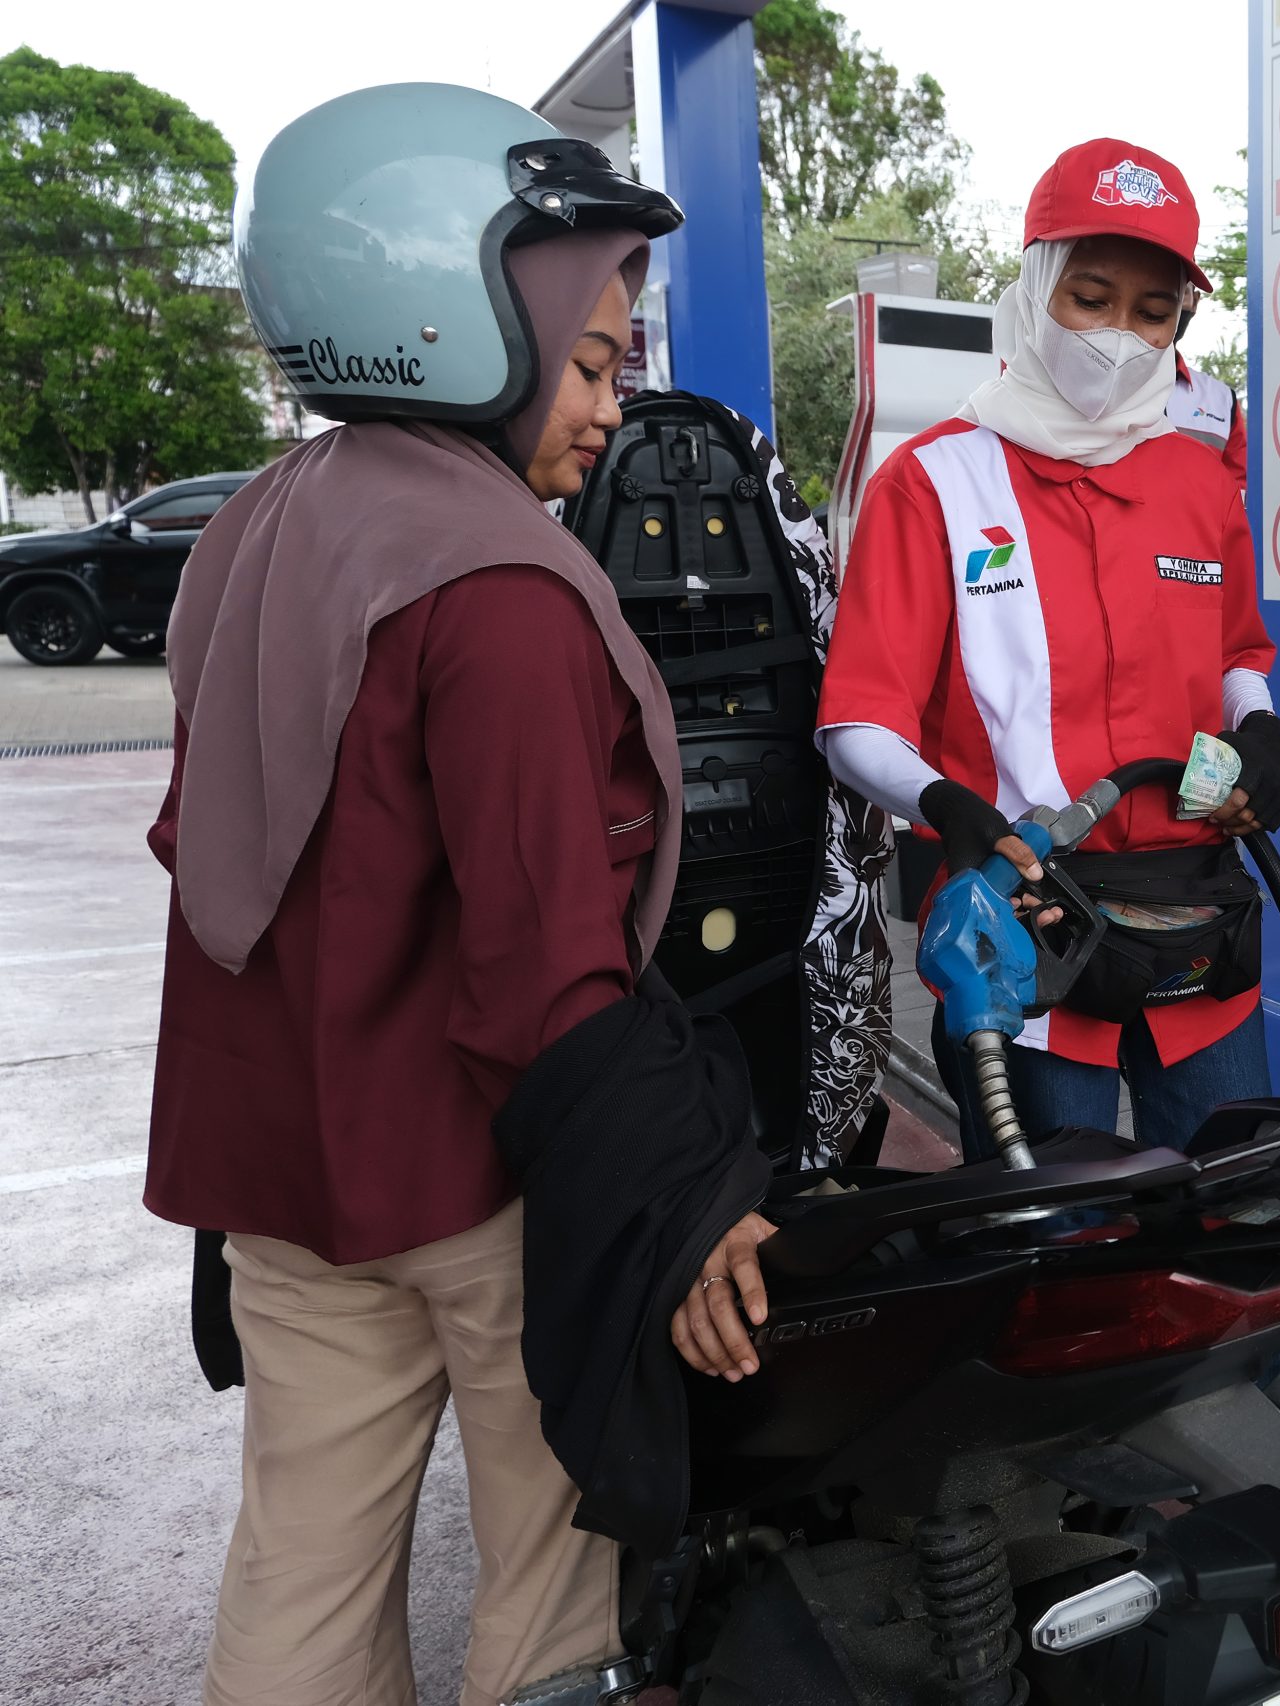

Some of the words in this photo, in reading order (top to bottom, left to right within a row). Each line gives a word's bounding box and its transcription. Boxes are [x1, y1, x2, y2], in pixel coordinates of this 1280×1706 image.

[1117, 172, 1134, 182] ON
[1135, 174, 1159, 191] THE
[1116, 181, 1157, 204] MOVE
[309, 336, 425, 386] Classic
[1171, 559, 1207, 573] YOHANA
[966, 578, 1024, 596] PERTAMINA
[1146, 984, 1204, 998] PERTAMINA
